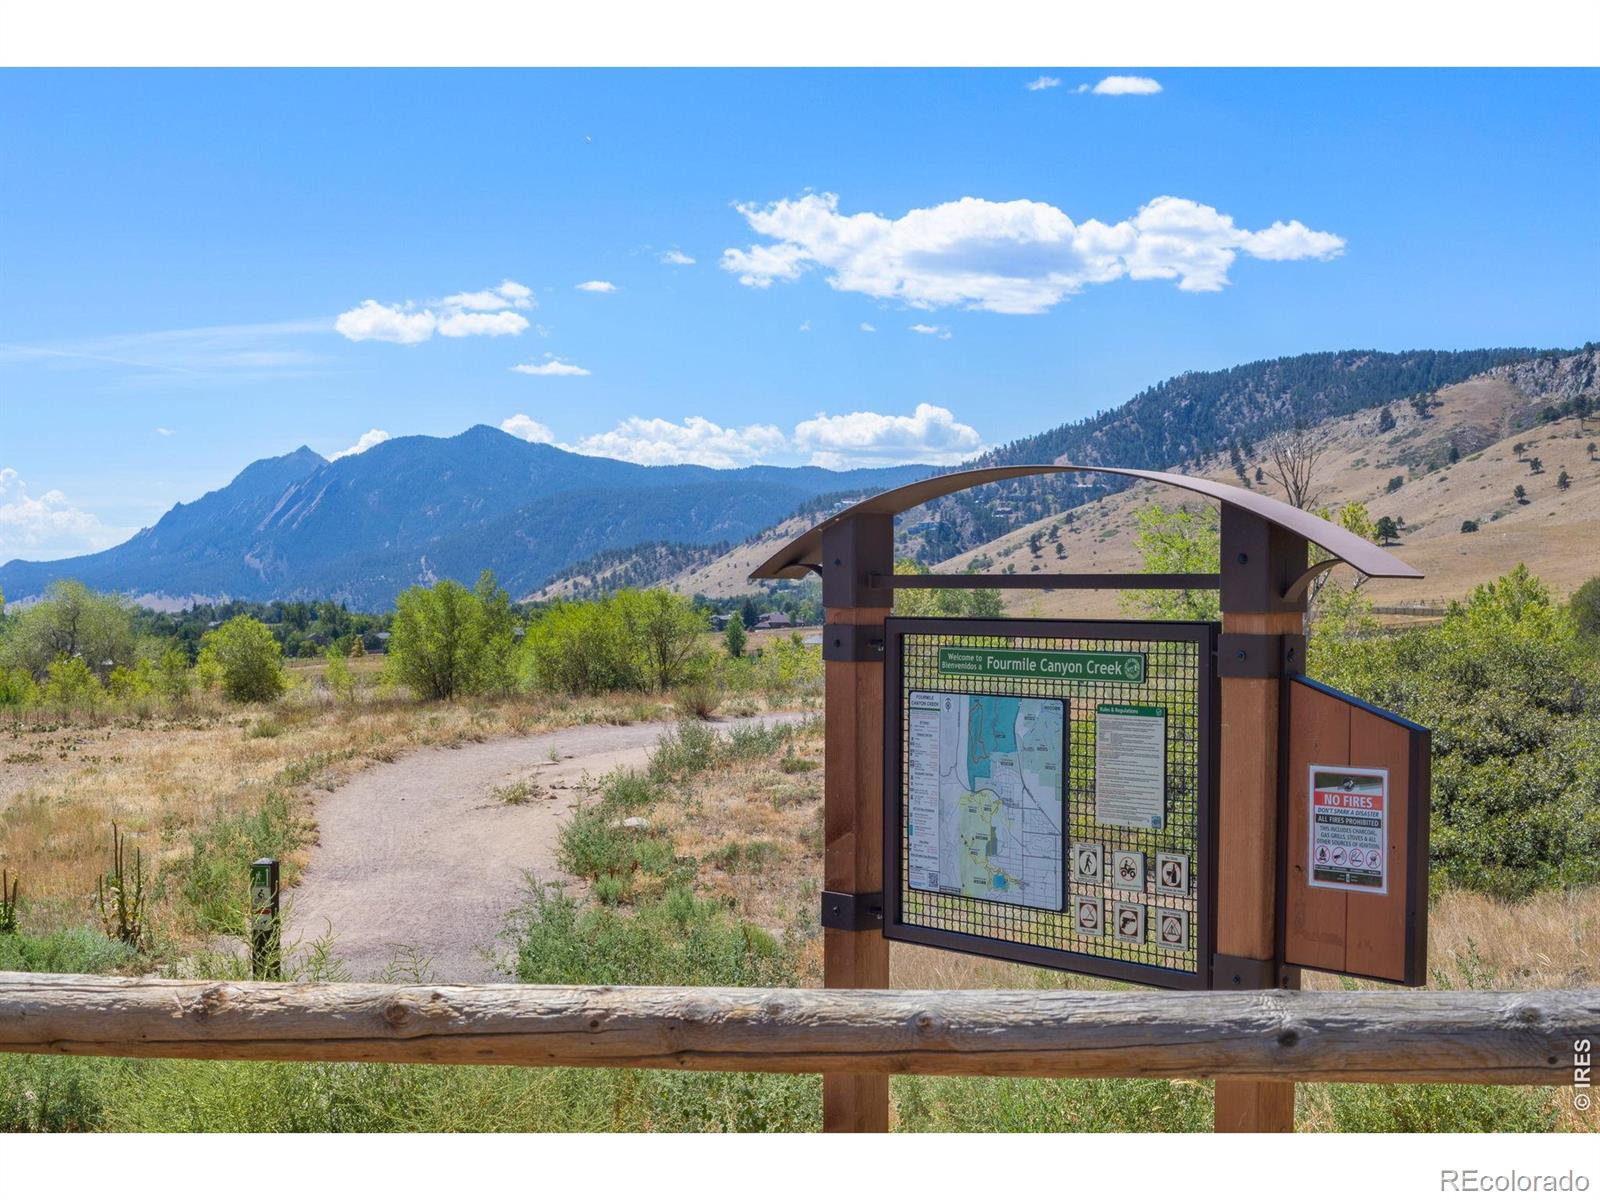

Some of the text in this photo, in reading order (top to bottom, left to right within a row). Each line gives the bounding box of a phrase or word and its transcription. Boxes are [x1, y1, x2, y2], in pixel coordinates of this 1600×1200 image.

[948, 653, 973, 661] Welcome
[942, 661, 977, 670] Bienvenidos
[987, 656, 1122, 676] Fourmile Canyon Creek
[1324, 794, 1373, 808] NO FIRES
[1329, 816, 1345, 824] FIRES
[1345, 818, 1379, 827] PROHIBITED
